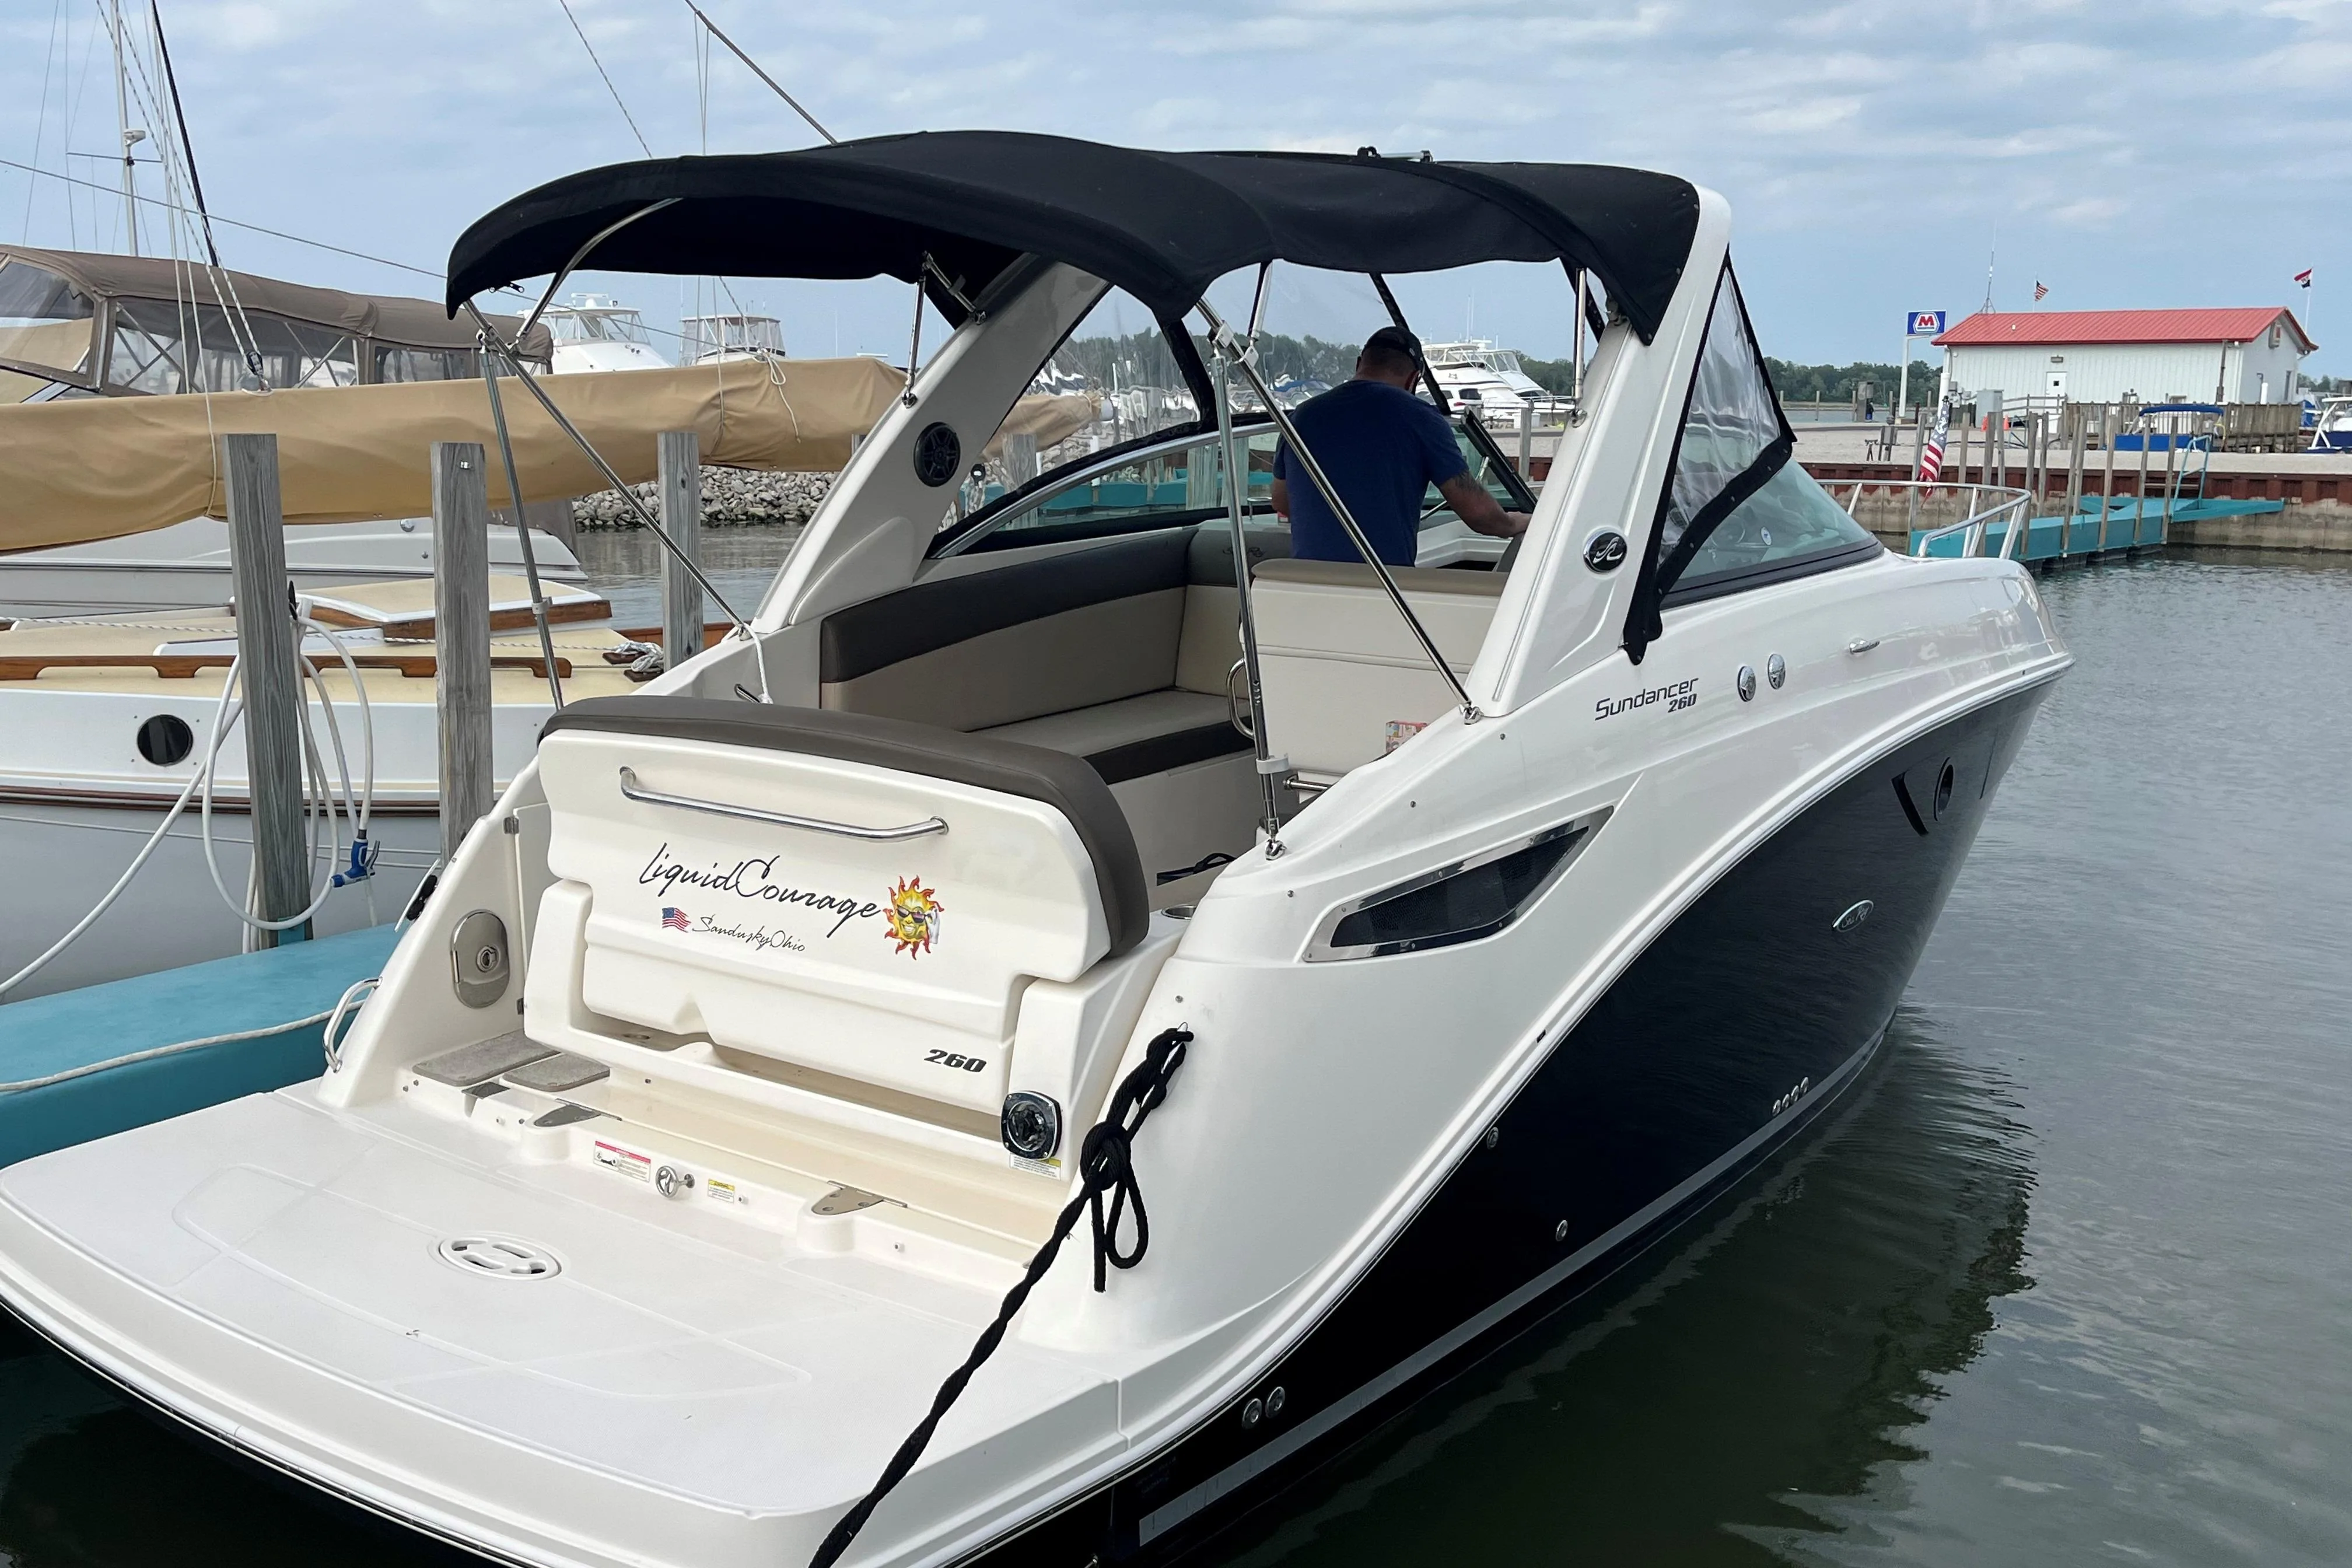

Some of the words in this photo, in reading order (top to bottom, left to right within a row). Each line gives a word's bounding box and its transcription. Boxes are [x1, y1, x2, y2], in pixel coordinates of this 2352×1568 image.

[1918, 316, 1934, 326] M
[1595, 678, 1699, 721] Sundancer
[1668, 693, 1697, 713] 260
[923, 1049, 987, 1073] 260
